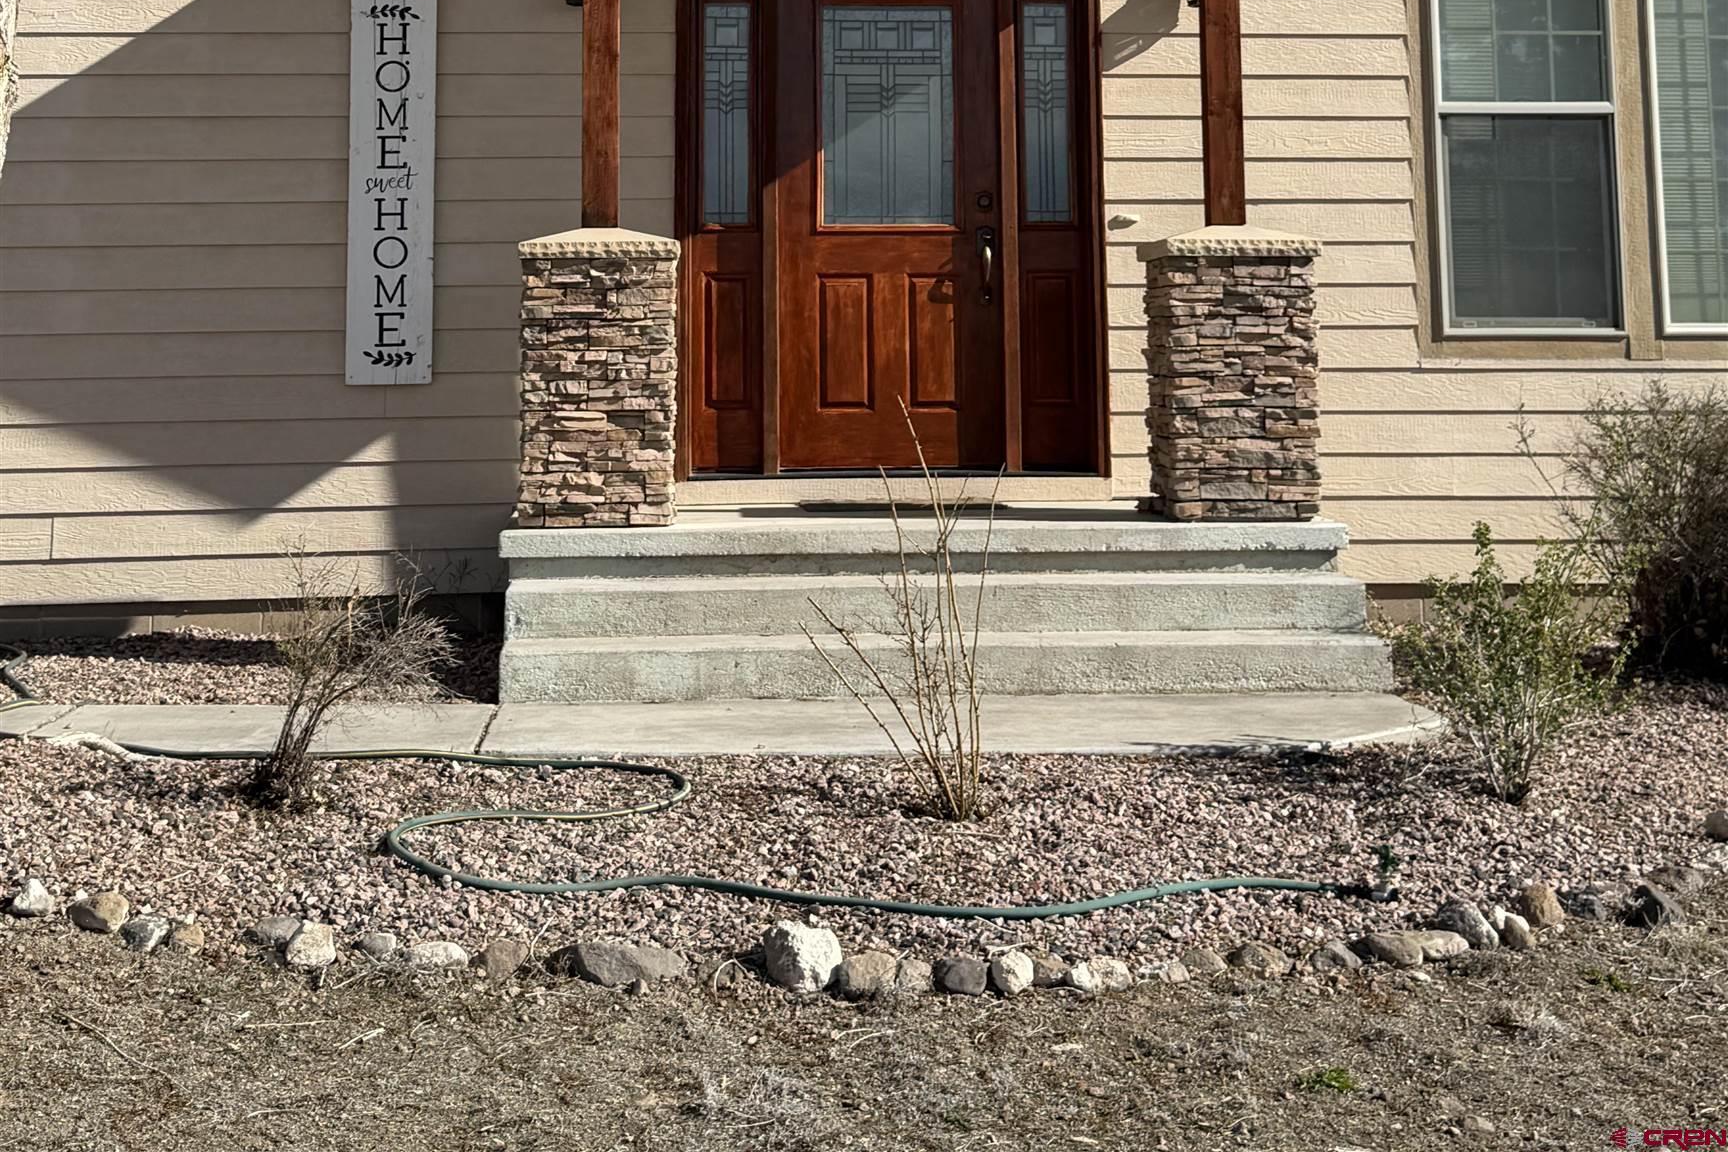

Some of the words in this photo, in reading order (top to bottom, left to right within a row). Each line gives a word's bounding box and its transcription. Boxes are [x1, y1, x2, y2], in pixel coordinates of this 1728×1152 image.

[375, 22, 411, 169] HOME
[364, 166, 420, 195] sweet
[373, 197, 409, 348] HOME
